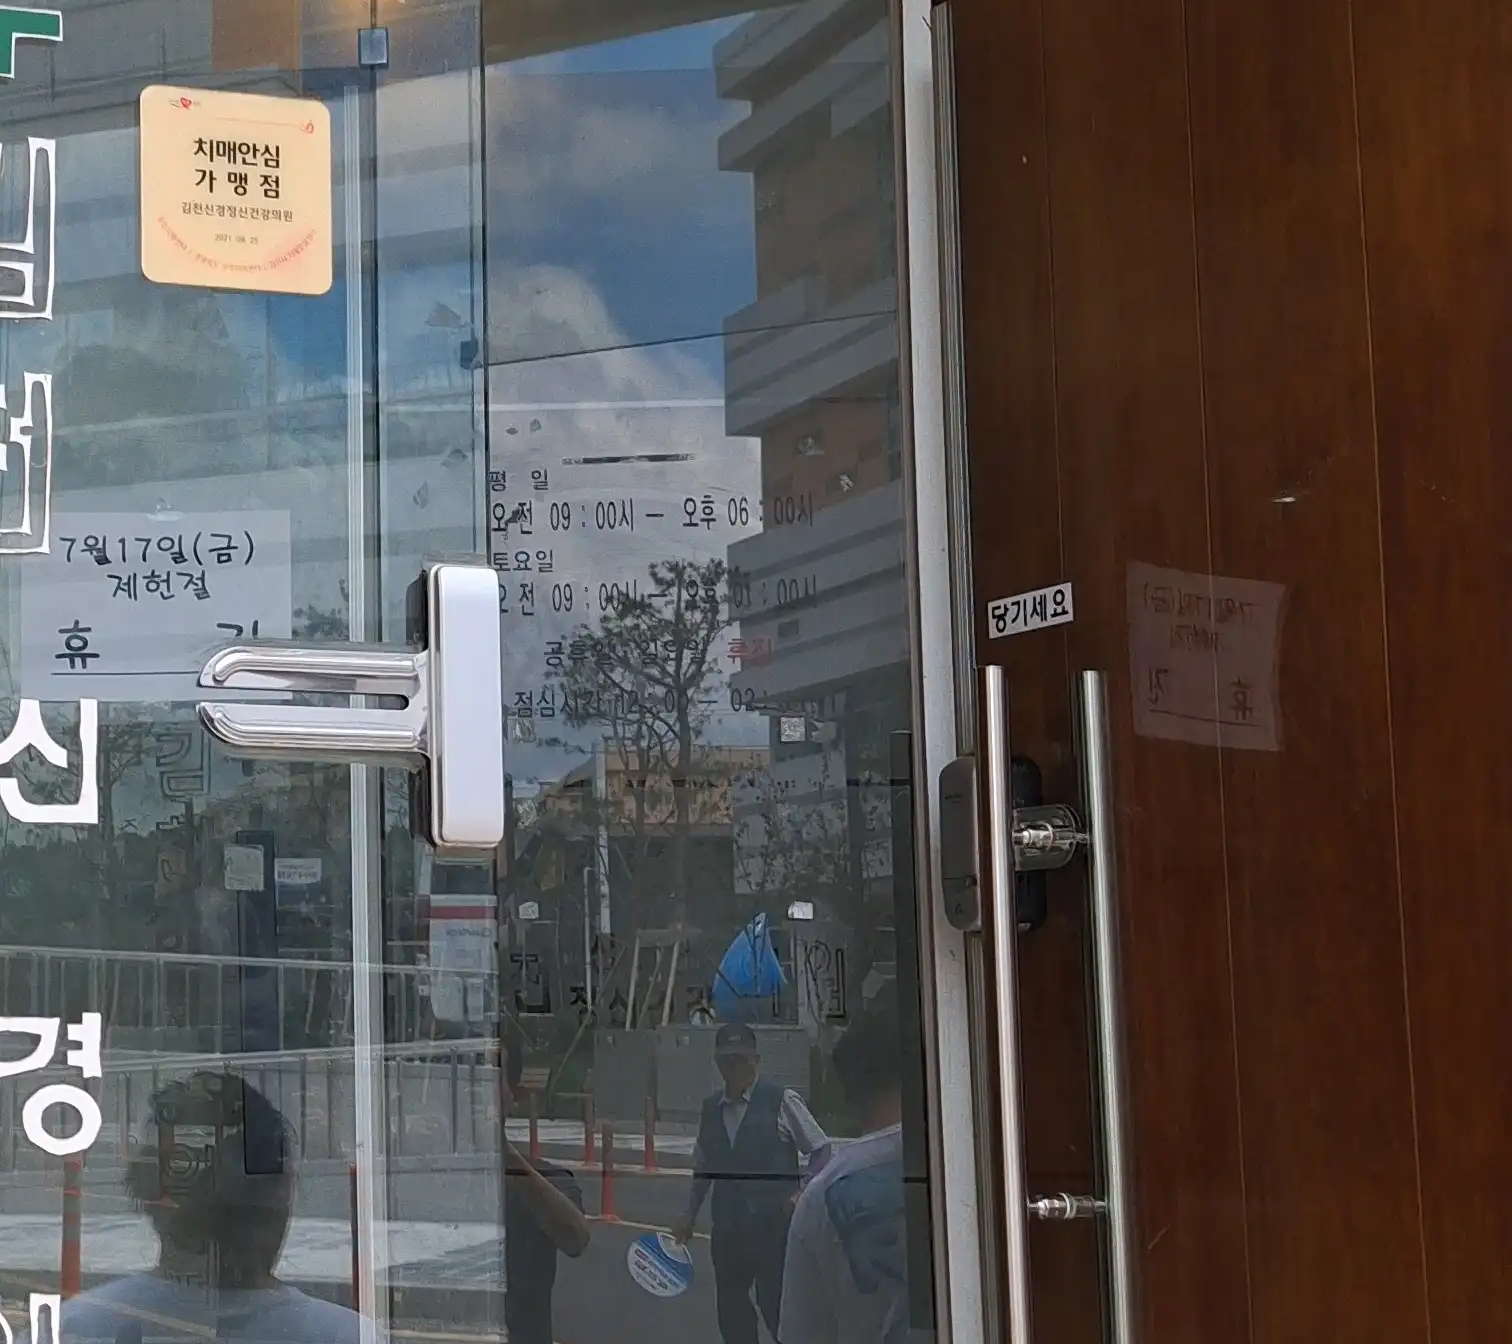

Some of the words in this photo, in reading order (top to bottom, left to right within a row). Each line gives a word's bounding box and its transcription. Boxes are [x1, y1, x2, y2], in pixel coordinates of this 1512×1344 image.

[192, 137, 281, 169] 치매안심
[682, 495, 717, 531] 오후
[492, 549, 554, 574] 토요일
[106, 569, 211, 601] 제헌절
[990, 588, 1070, 634] 당기세요
